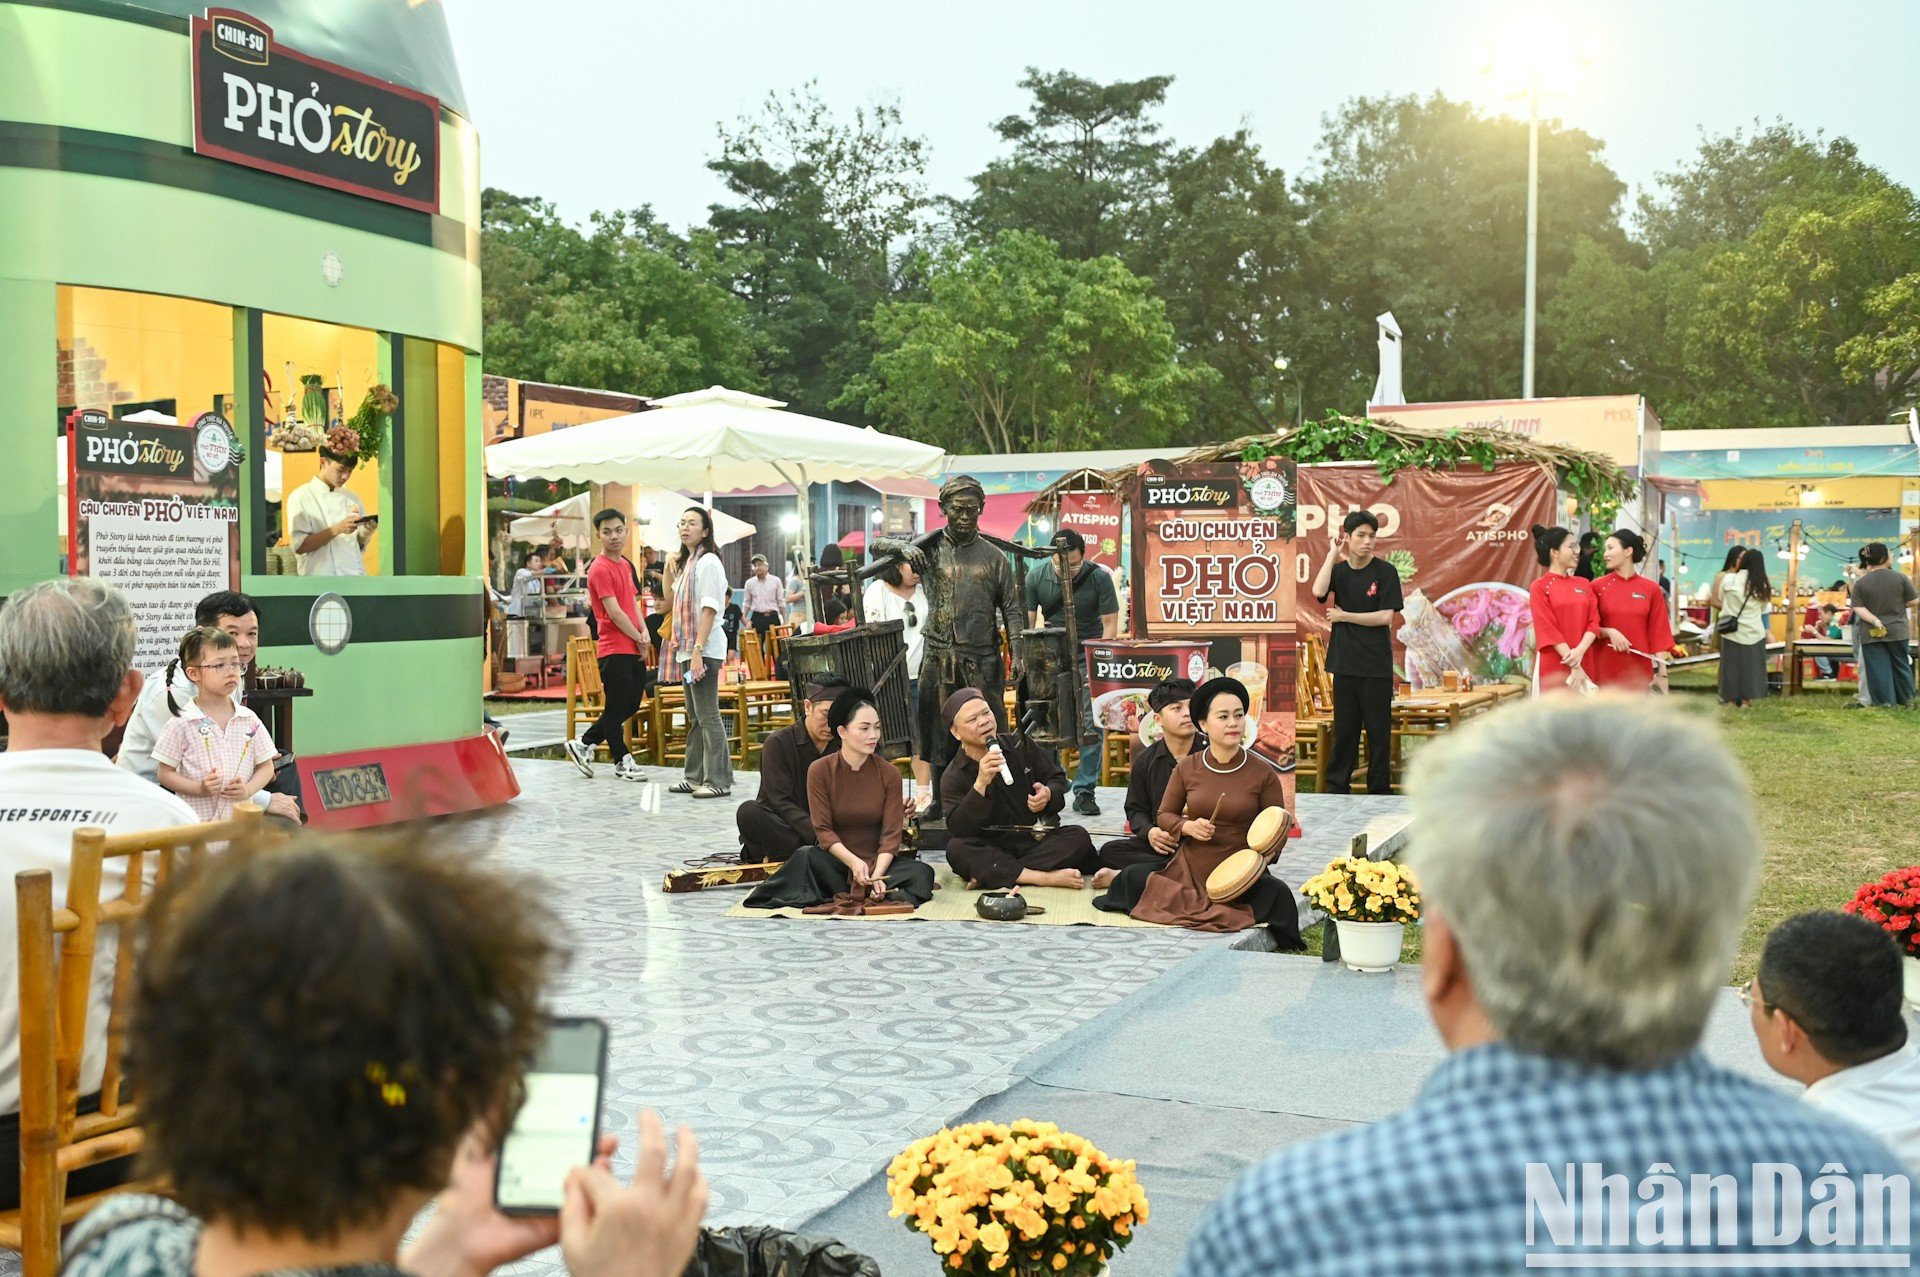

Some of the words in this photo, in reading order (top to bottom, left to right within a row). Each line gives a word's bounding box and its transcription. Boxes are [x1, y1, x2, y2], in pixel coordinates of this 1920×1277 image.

[217, 23, 264, 52] CHIN-SU
[223, 72, 332, 154] PHỞ
[331, 105, 421, 185] story
[84, 415, 106, 425] CHIN-SU
[86, 431, 139, 465] PHỞ
[138, 438, 184, 473] story
[1148, 484, 1191, 504] PHỞ
[1190, 485, 1231, 506] story
[80, 500, 100, 515] CÂU
[102, 502, 140, 519] CHUYỆN
[143, 496, 183, 523] PHỞ
[186, 503, 211, 522] VIỆT
[213, 507, 238, 520] NAM
[1061, 512, 1120, 526] ATISPHO
[1296, 503, 1401, 538] PHO
[1081, 534, 1098, 545] TISO
[1161, 519, 1197, 539] CÂU
[1202, 518, 1276, 541] CHUYỆN
[1466, 529, 1529, 541] ATISPHO
[1161, 543, 1278, 597] PHỞ
[1162, 598, 1215, 624] VIỆT
[1224, 602, 1274, 620] NAM
[1097, 658, 1137, 679] PHỞ
[1136, 661, 1173, 681] story
[28, 808, 93, 822] SPORTS
